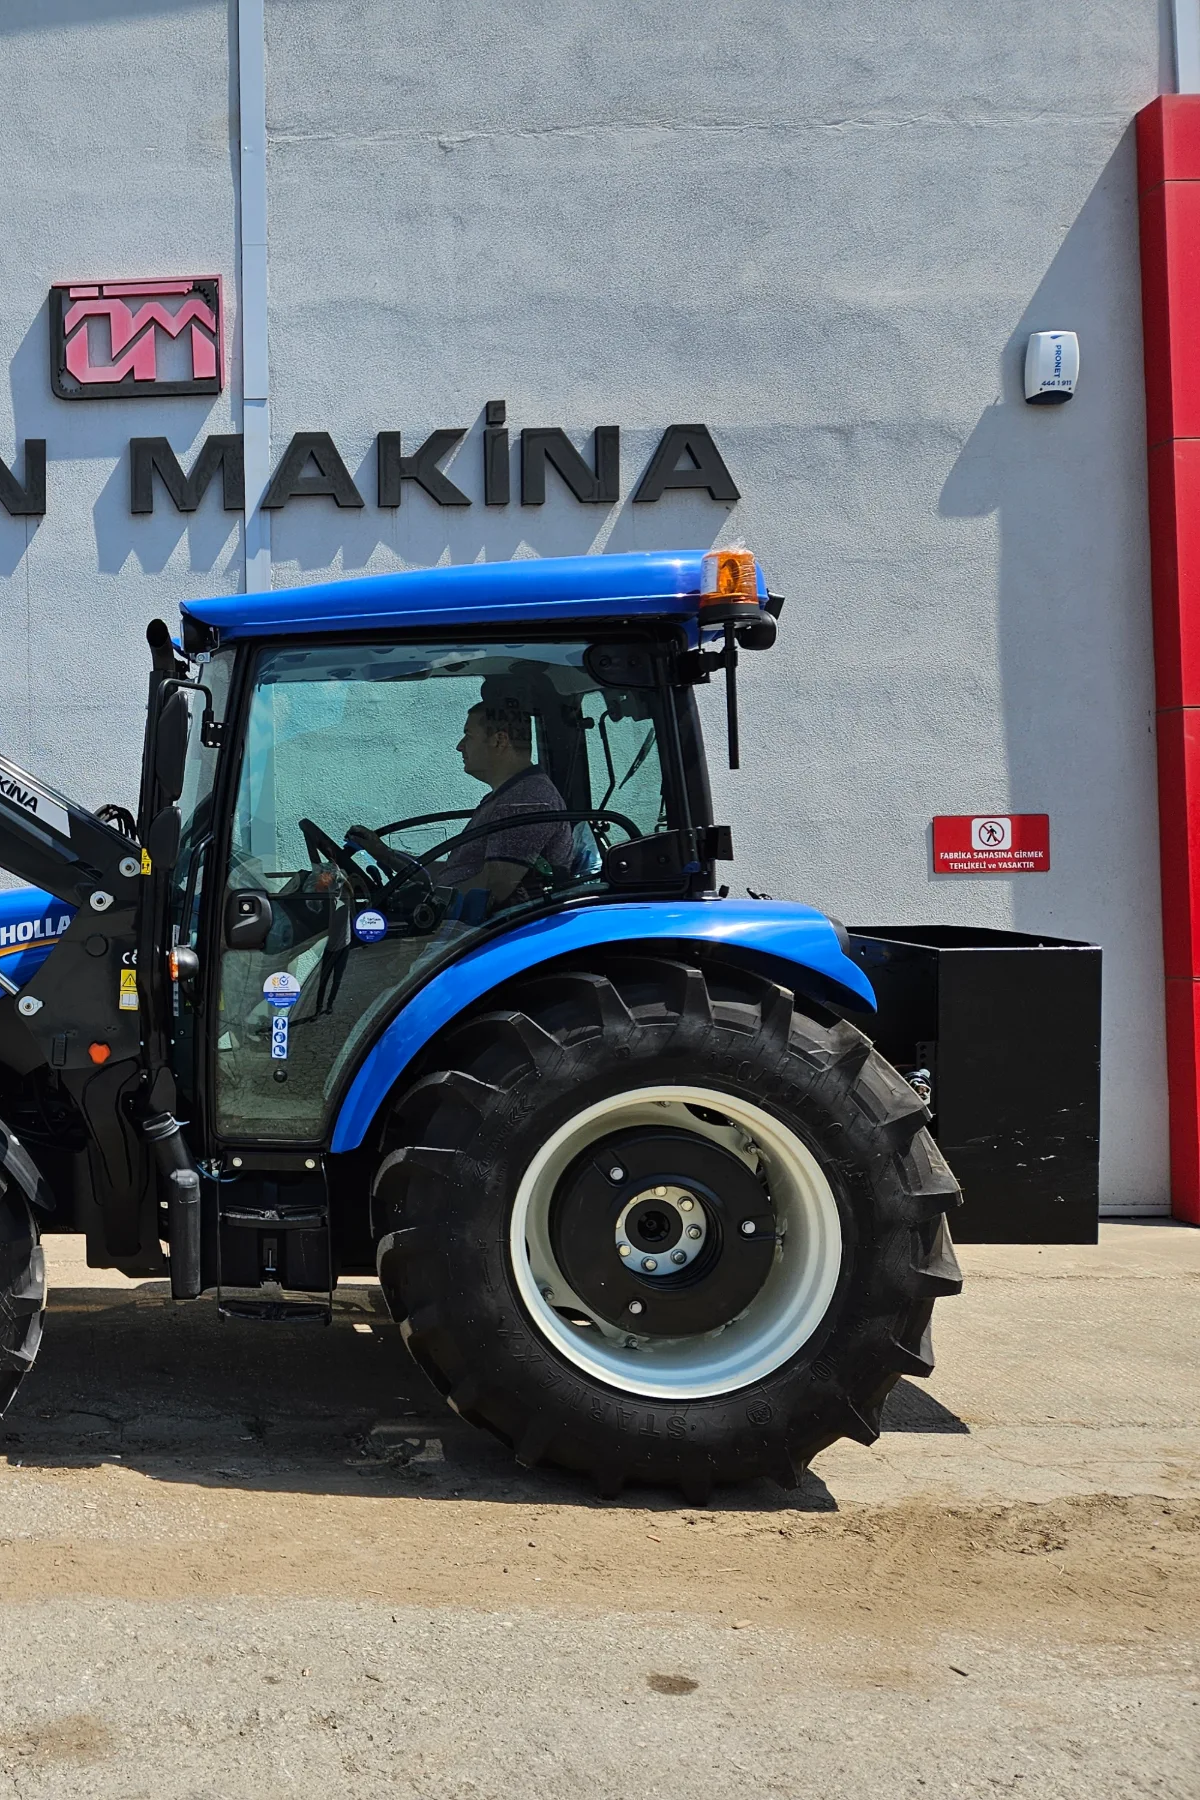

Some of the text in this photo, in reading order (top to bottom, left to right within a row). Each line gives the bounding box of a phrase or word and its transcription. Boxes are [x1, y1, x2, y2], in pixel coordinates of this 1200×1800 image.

[1053, 344, 1062, 378] PRONET
[129, 400, 742, 515] MAKİNA
[940, 850, 1044, 860] FABRİKA SAHASINA GİRMEK
[949, 860, 987, 870] TEHLİKELİ
[998, 861, 1035, 869] YASAKTIR
[0, 915, 72, 946] HOLLA
